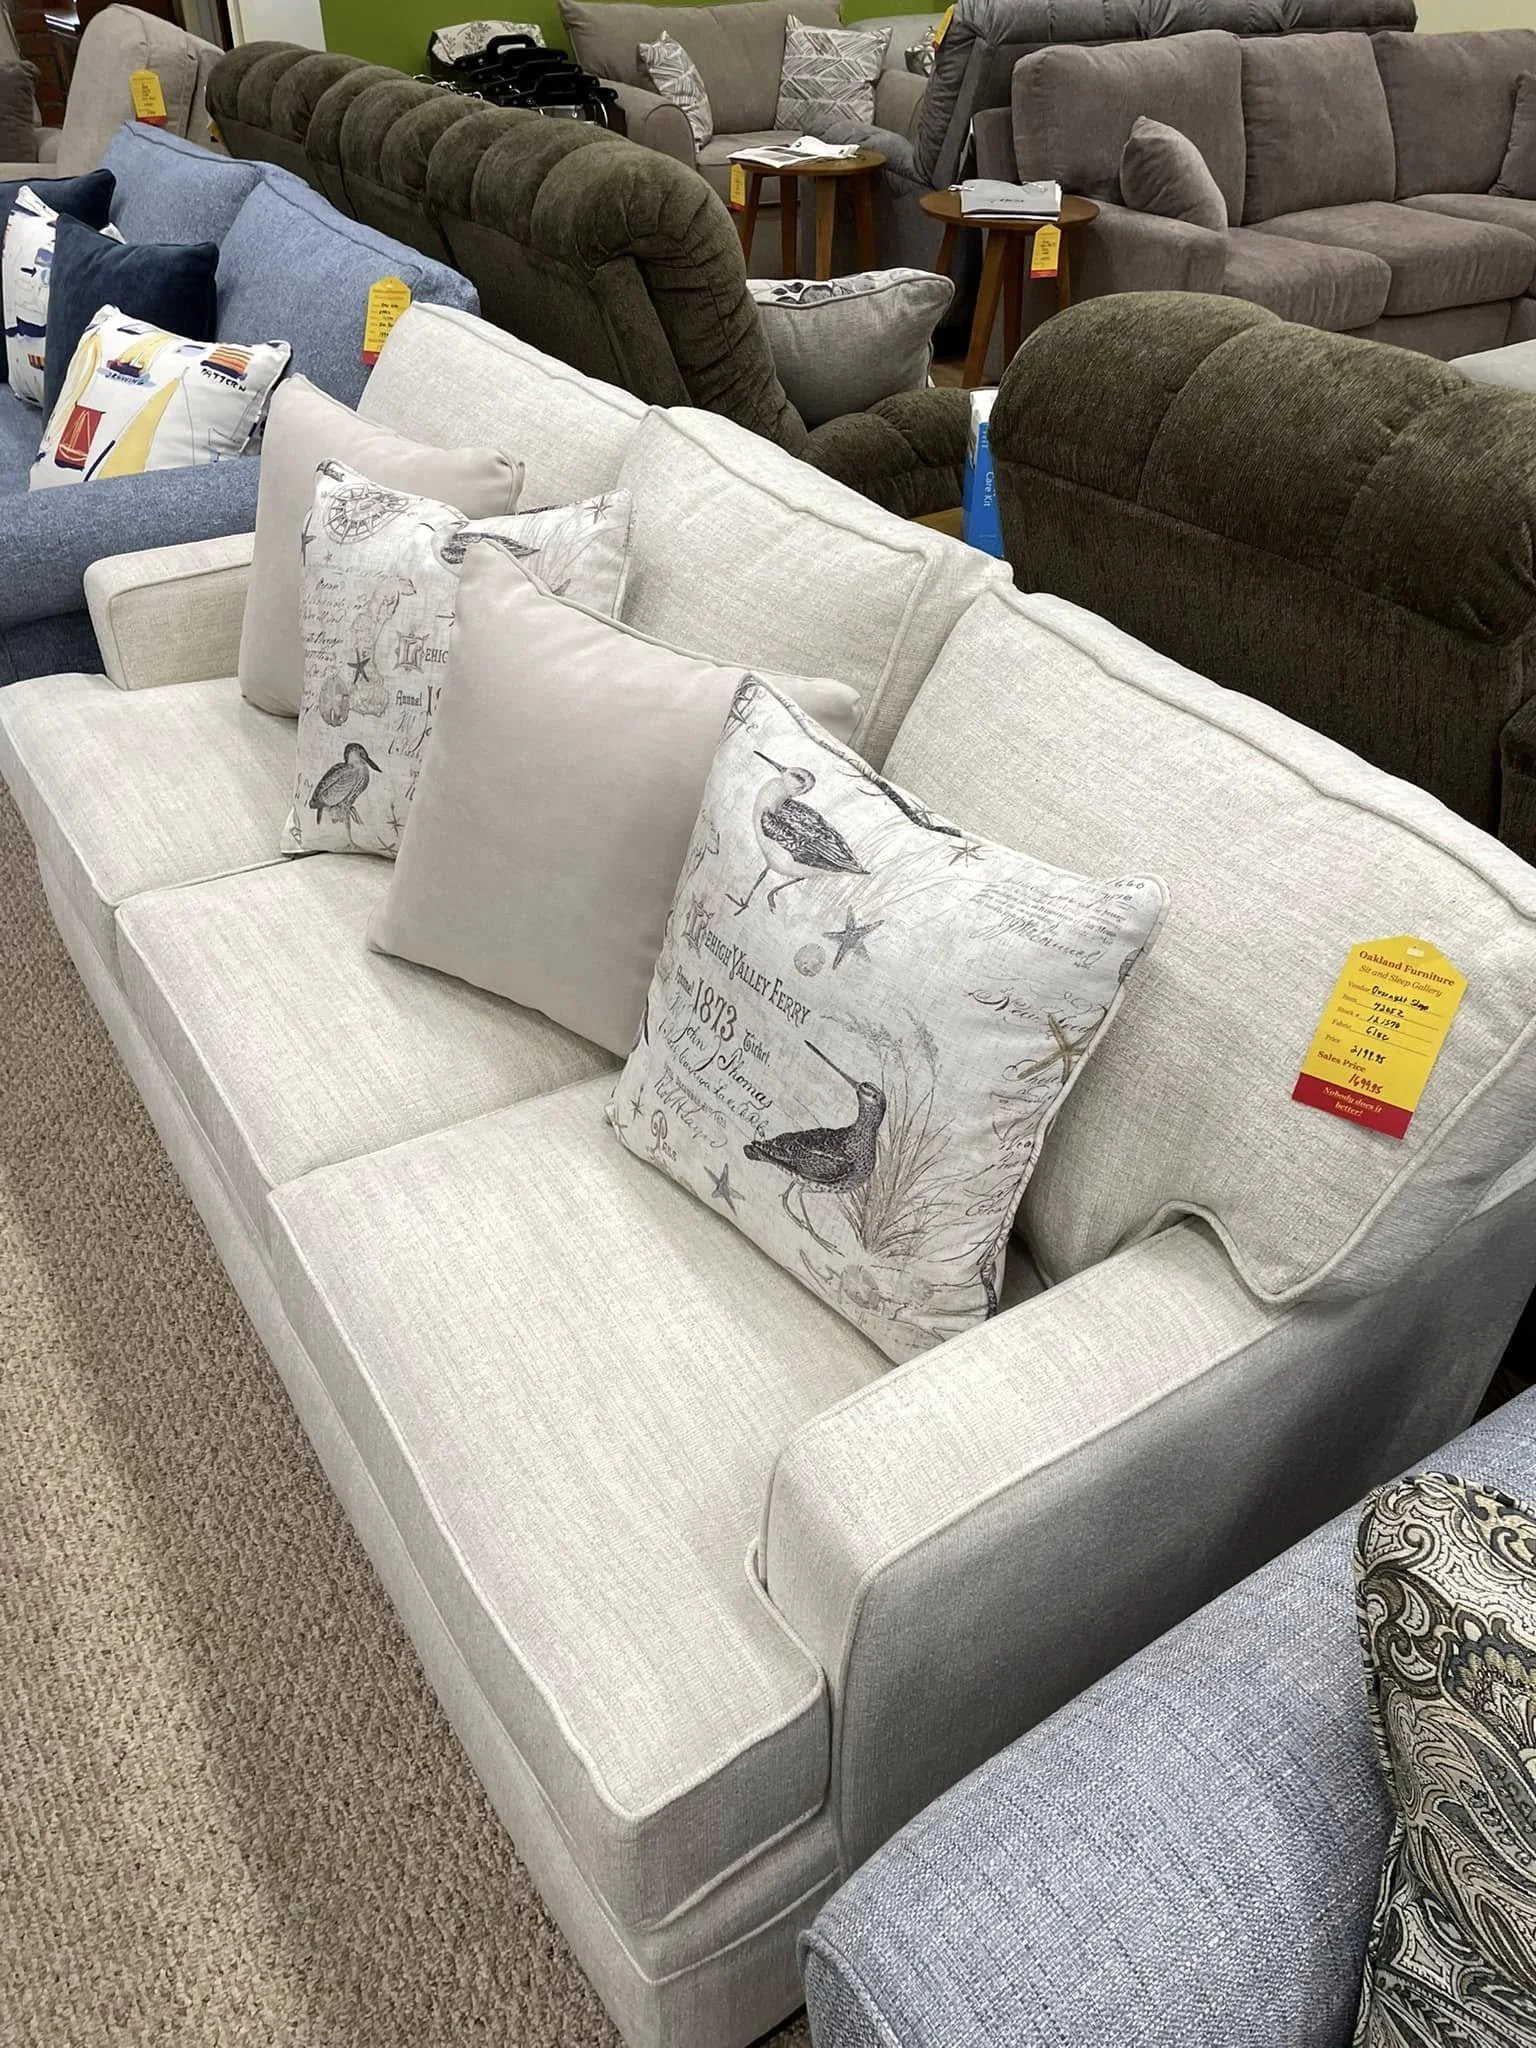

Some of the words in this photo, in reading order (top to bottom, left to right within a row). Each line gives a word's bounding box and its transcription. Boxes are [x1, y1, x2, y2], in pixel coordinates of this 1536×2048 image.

[984, 471, 995, 493] Care
[983, 494, 993, 507] Kit
[1359, 949, 1402, 971] Oakland
[1404, 964, 1456, 987] Furniture
[728, 943, 772, 997] VALLEY
[768, 977, 812, 1029] FERRY
[1359, 964, 1371, 975] Sit
[1371, 969, 1389, 980] and
[1388, 974, 1411, 988] Sleep
[1411, 981, 1443, 998] Gallery
[693, 976, 738, 1042] 1873
[1317, 1050, 1341, 1064] Sales
[1342, 1059, 1367, 1073] Price
[1322, 1086, 1356, 1104] Nobody
[1354, 1098, 1375, 1110] does
[1334, 1101, 1364, 1117] better!
